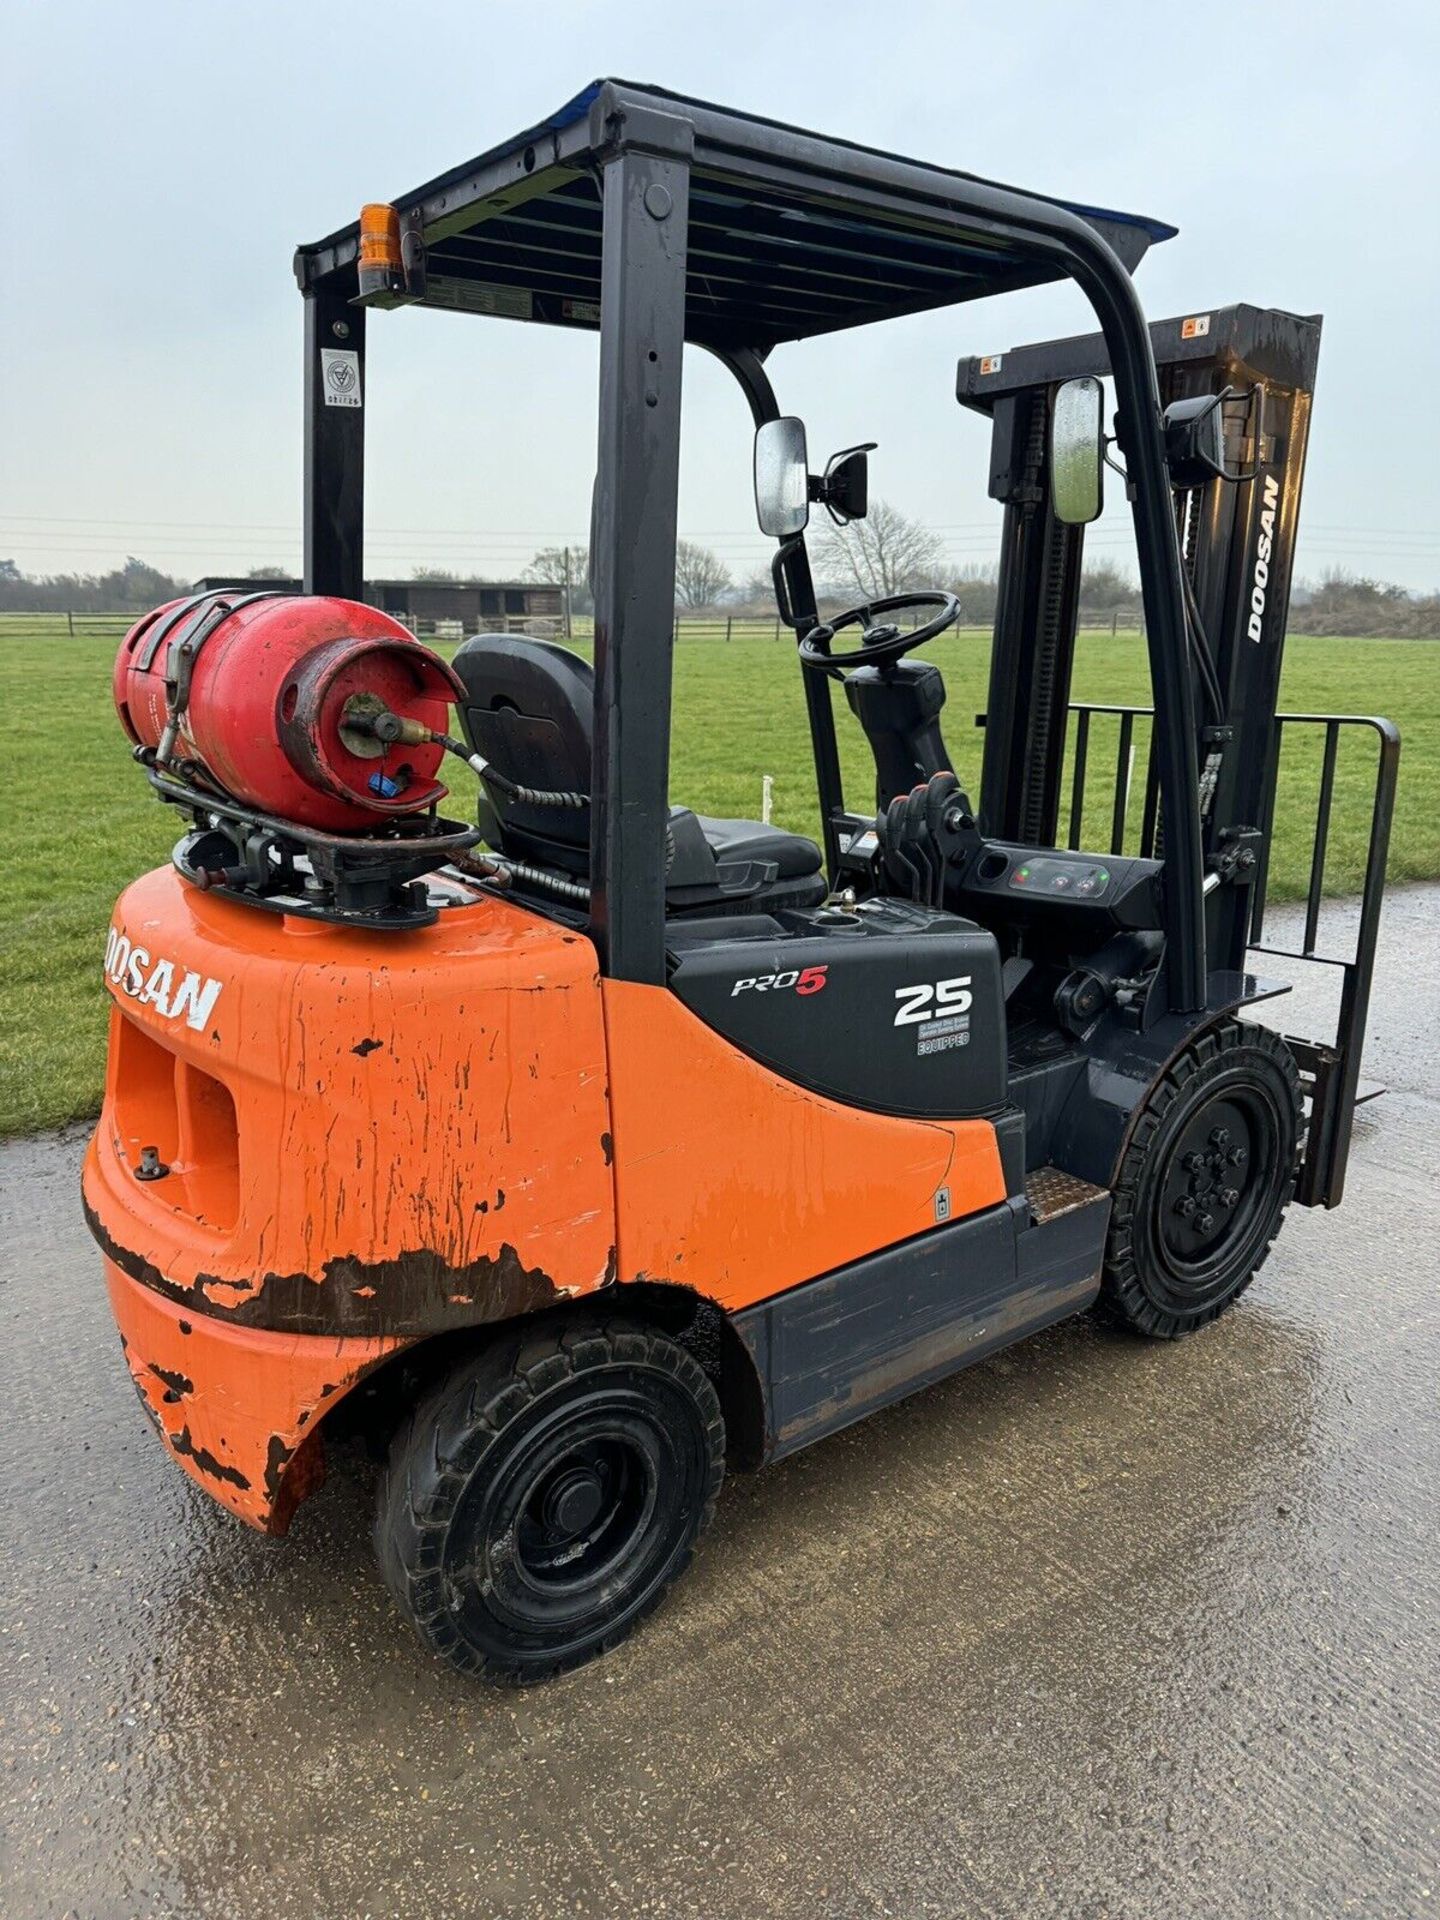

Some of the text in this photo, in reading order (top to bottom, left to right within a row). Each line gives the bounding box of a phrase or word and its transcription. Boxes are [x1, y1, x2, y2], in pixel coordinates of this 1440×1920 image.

[1247, 474, 1279, 643] DOOSAN
[104, 926, 223, 1032] OOSAN
[730, 965, 829, 997] PRO5
[894, 976, 973, 1026] 25
